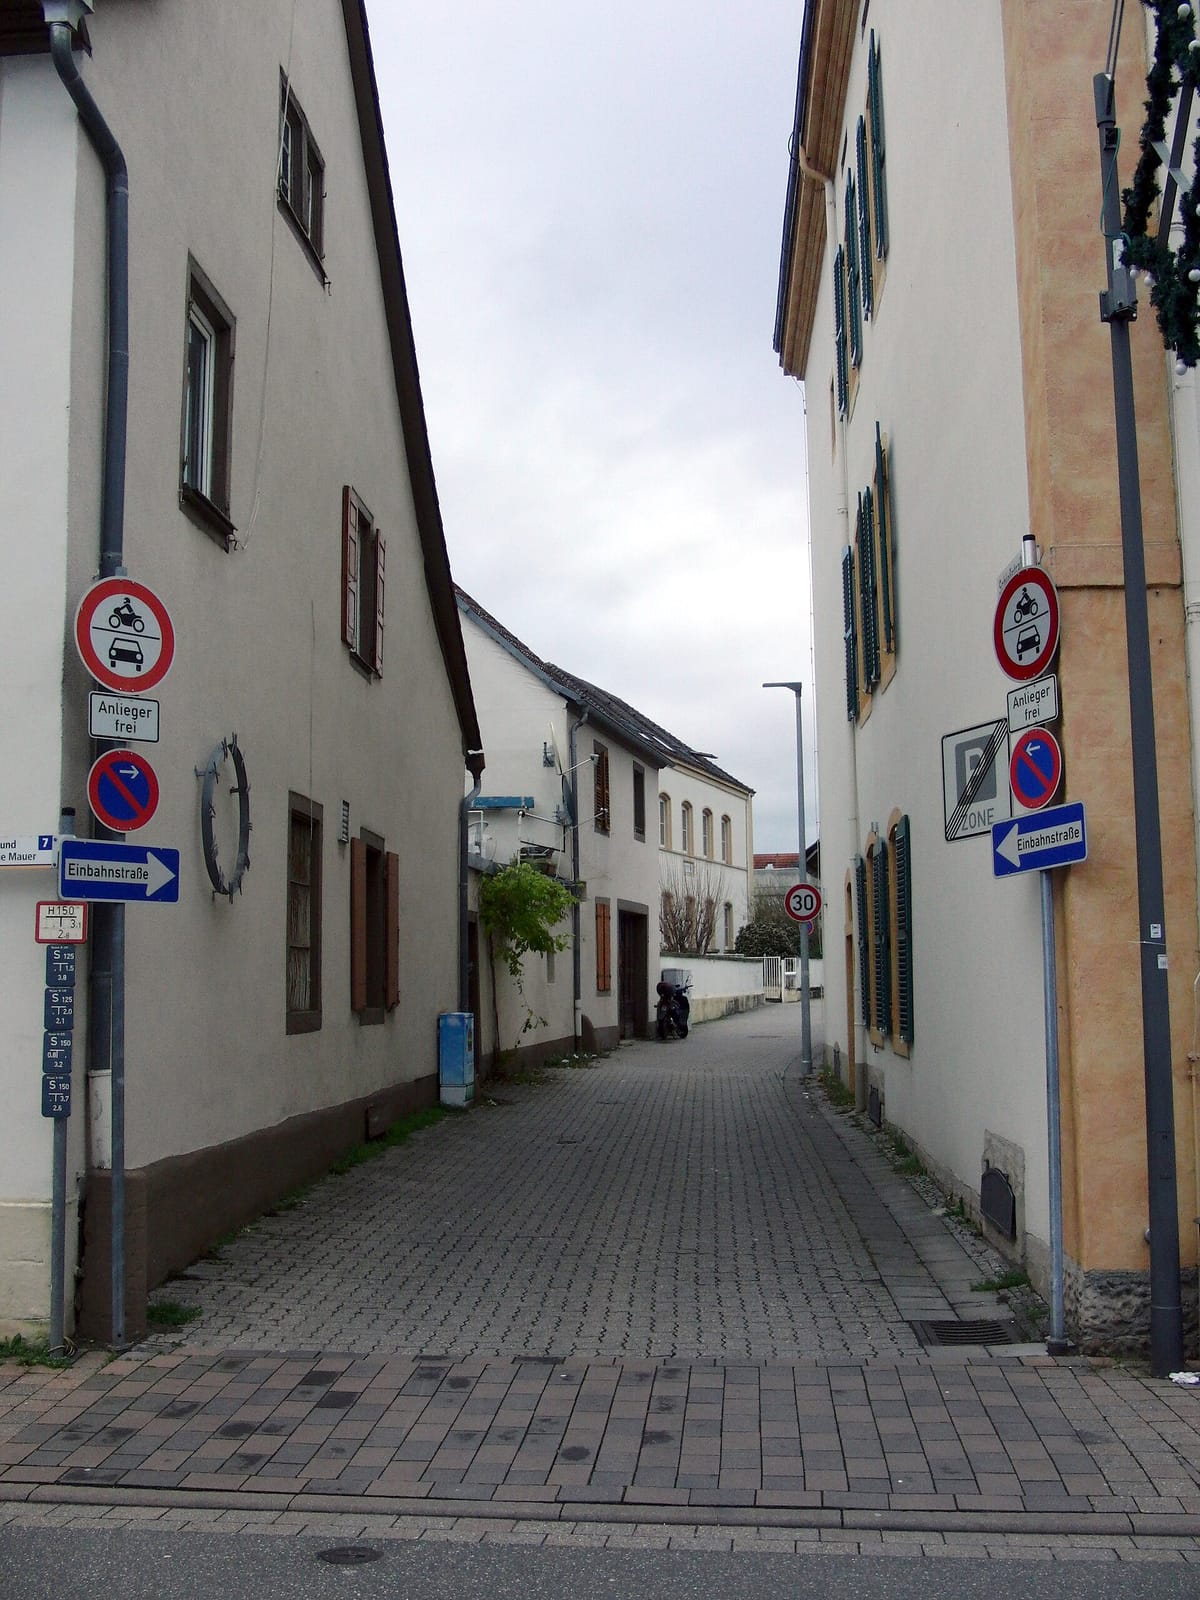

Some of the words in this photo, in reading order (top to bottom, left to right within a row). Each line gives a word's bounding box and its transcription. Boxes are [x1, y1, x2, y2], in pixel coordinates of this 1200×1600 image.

[1012, 686, 1051, 709] Anlieger
[98, 700, 153, 720] Anlieger
[1024, 705, 1041, 721] frei
[115, 719, 137, 734] frei
[961, 807, 995, 831] ZONE
[0, 839, 17, 849] und
[41, 837, 49, 848] 7
[1017, 827, 1080, 851] Einbahnstraße
[8, 852, 37, 861] Mauer
[68, 862, 149, 880] Einbahnstraße
[792, 894, 814, 911] 30
[53, 950, 61, 960] S
[52, 993, 59, 1003] S
[50, 1036, 58, 1046] S
[49, 1080, 56, 1090] S
